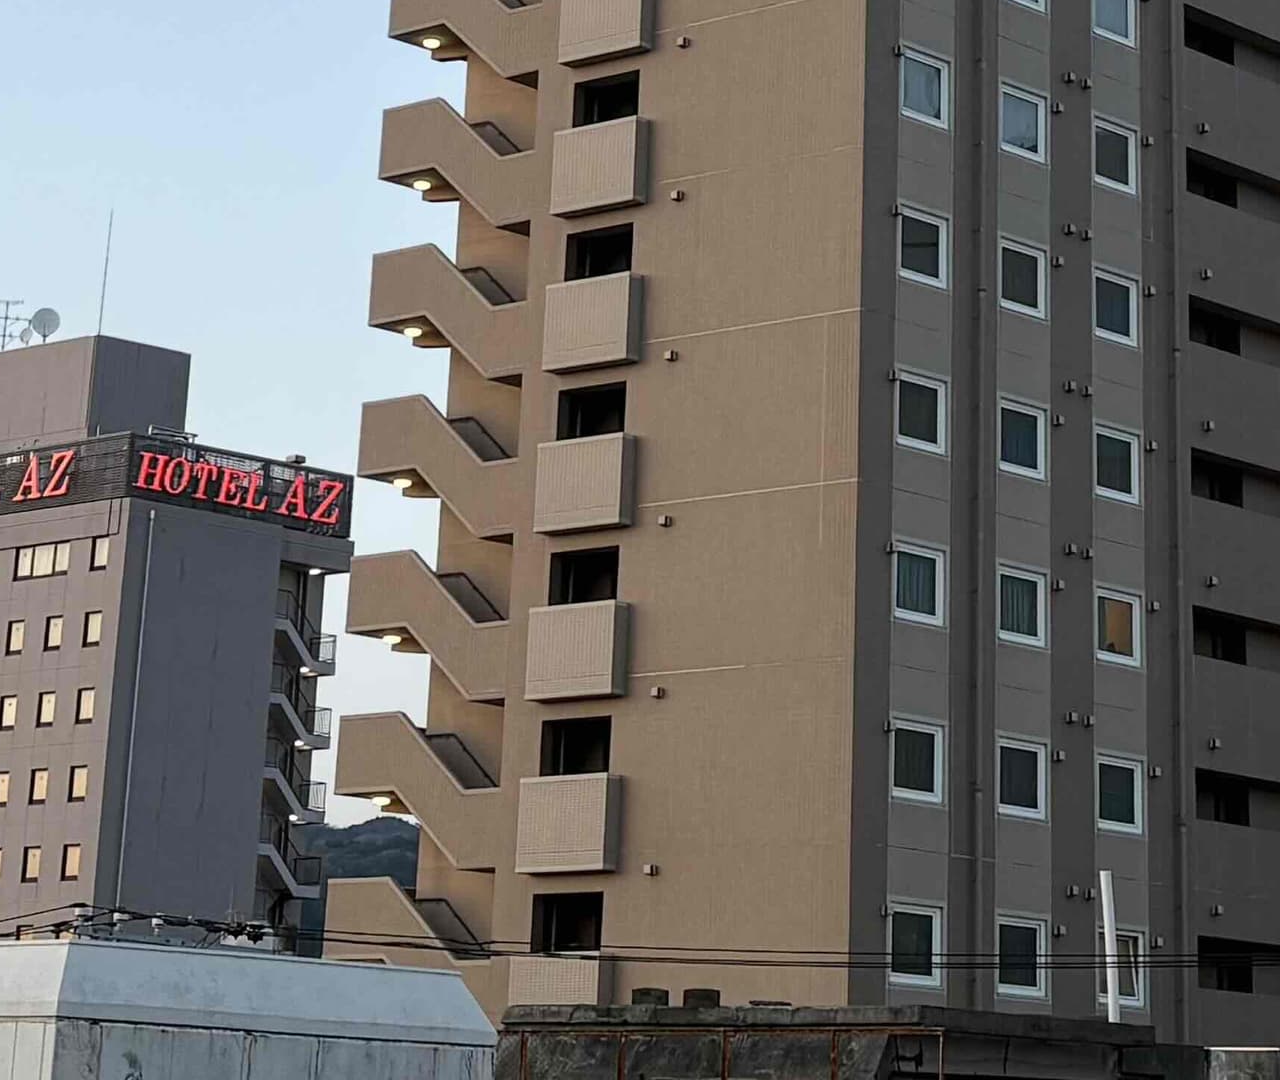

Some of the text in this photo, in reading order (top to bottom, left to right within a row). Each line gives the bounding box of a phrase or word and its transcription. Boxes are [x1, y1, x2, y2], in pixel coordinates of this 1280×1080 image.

[12, 449, 76, 502] AZ
[132, 451, 345, 526] HOTEL AZ
